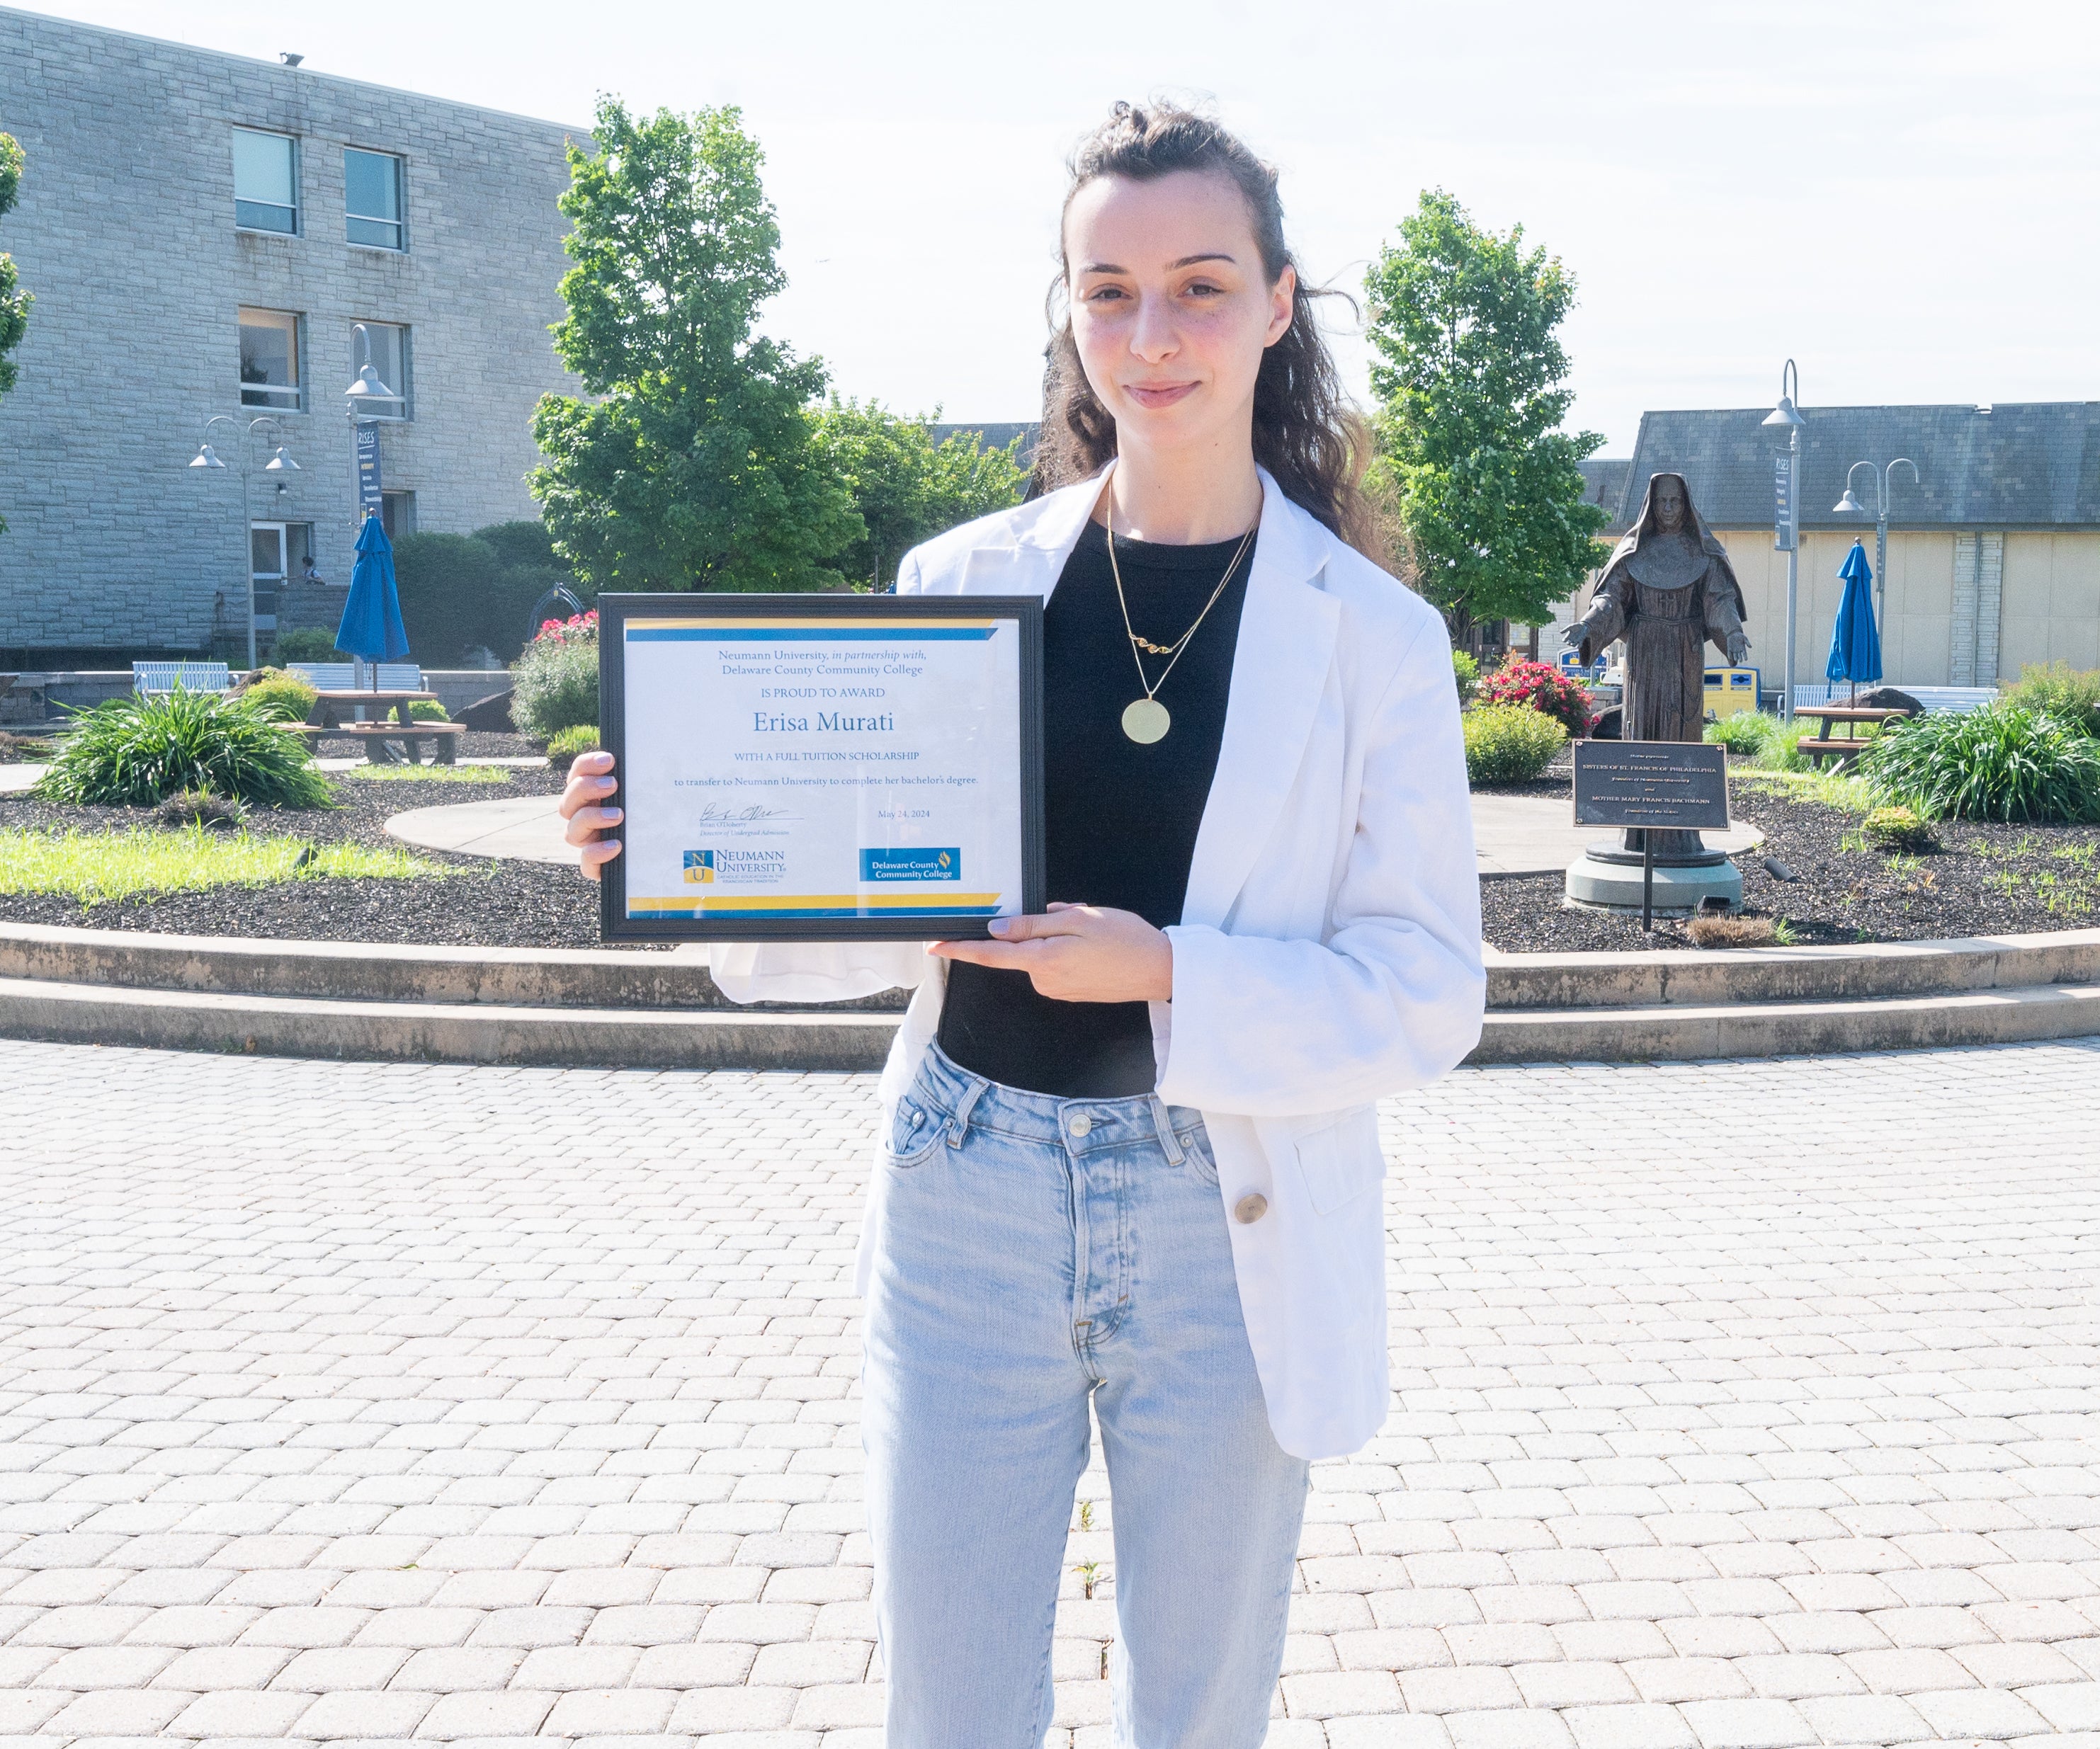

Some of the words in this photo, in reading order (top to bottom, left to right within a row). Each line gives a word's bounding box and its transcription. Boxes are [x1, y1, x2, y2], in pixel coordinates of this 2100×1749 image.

[358, 431, 375, 445] RISES
[1776, 457, 1789, 471] RISES
[718, 650, 771, 660] Neumann
[774, 650, 829, 663] University,
[832, 650, 841, 660] in
[844, 649, 899, 662] partnership
[902, 649, 927, 661] with,
[722, 665, 771, 675] Delaware
[774, 665, 814, 677] County
[817, 665, 880, 677] Community
[883, 664, 923, 677] College
[761, 688, 771, 697] IS
[774, 688, 817, 697] PROUD
[819, 688, 836, 697] TO
[840, 688, 885, 697] AWARD
[753, 712, 809, 731] Erisa
[816, 712, 895, 731] Murati
[734, 753, 763, 761] WITH
[766, 753, 773, 761] A
[775, 753, 799, 761] FULL
[801, 752, 846, 761] TUITION
[848, 751, 919, 761] SCHOLARSHIP
[686, 777, 721, 786] transfer
[735, 777, 779, 786] Neumann
[781, 776, 827, 788] University
[841, 776, 882, 788] complete
[885, 775, 899, 786] her
[901, 775, 945, 785] bachelor's
[946, 775, 979, 788] degree.
[878, 809, 895, 819] May
[897, 809, 909, 819] 24,
[911, 809, 930, 819] 2024
[693, 853, 705, 866] N
[716, 850, 784, 861] NEUMANN
[909, 861, 939, 870] County
[693, 869, 705, 881] U
[875, 870, 922, 879] Community
[923, 870, 953, 879] College
